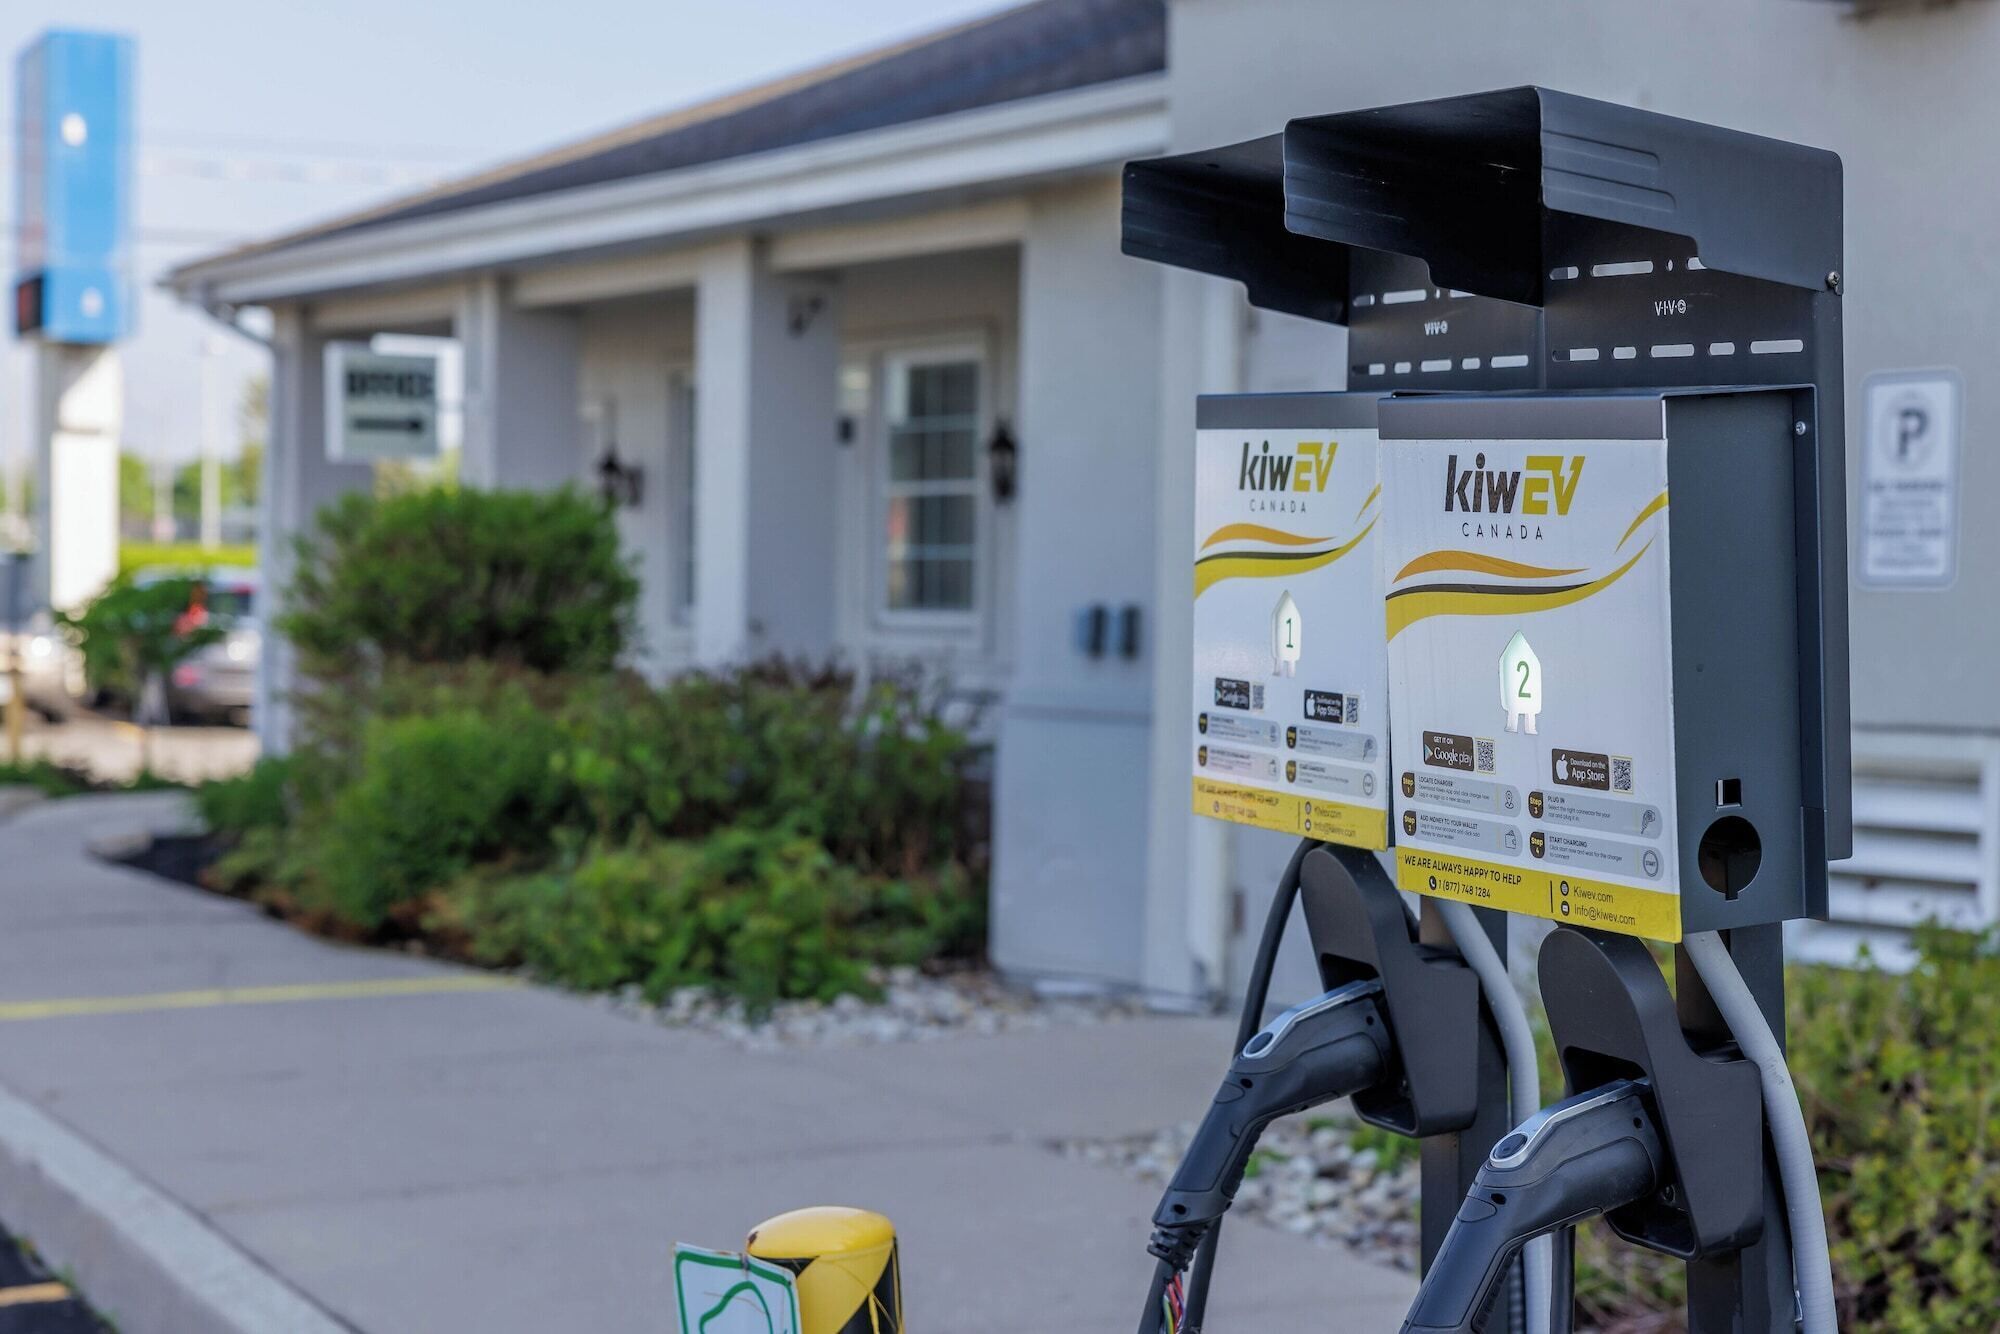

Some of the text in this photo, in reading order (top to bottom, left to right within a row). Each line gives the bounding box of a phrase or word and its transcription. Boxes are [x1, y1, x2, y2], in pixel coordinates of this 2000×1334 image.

[1898, 407, 1930, 457] P
[1238, 440, 1339, 493] kiwEV
[1444, 452, 1586, 516] kiwEV
[1250, 499, 1307, 513] CANADA
[1461, 522, 1543, 540] CANADA
[1286, 617, 1294, 649] 1
[1516, 660, 1532, 698] 2
[1446, 737, 1454, 745] ON
[1434, 746, 1473, 767] Google play
[1570, 757, 1591, 768] Download
[1571, 768, 1605, 782] App Store
[1529, 797, 1542, 807] Step
[1547, 795, 1560, 804] PLUG
[1429, 816, 1444, 824] MONEY
[1450, 819, 1462, 827] YOUR
[1462, 821, 1478, 830] WALLET
[1531, 837, 1543, 847] Step
[1549, 836, 1587, 848] START CHARGING
[1535, 847, 1540, 855] 4
[1404, 854, 1522, 886] WE ARE ALWAYS HAPPY TO HELP
[1438, 880, 1491, 898] 1 (877) 748 1284
[1573, 886, 1614, 903] Kiwev.com
[1574, 904, 1636, 925] Info@kiwev.com
